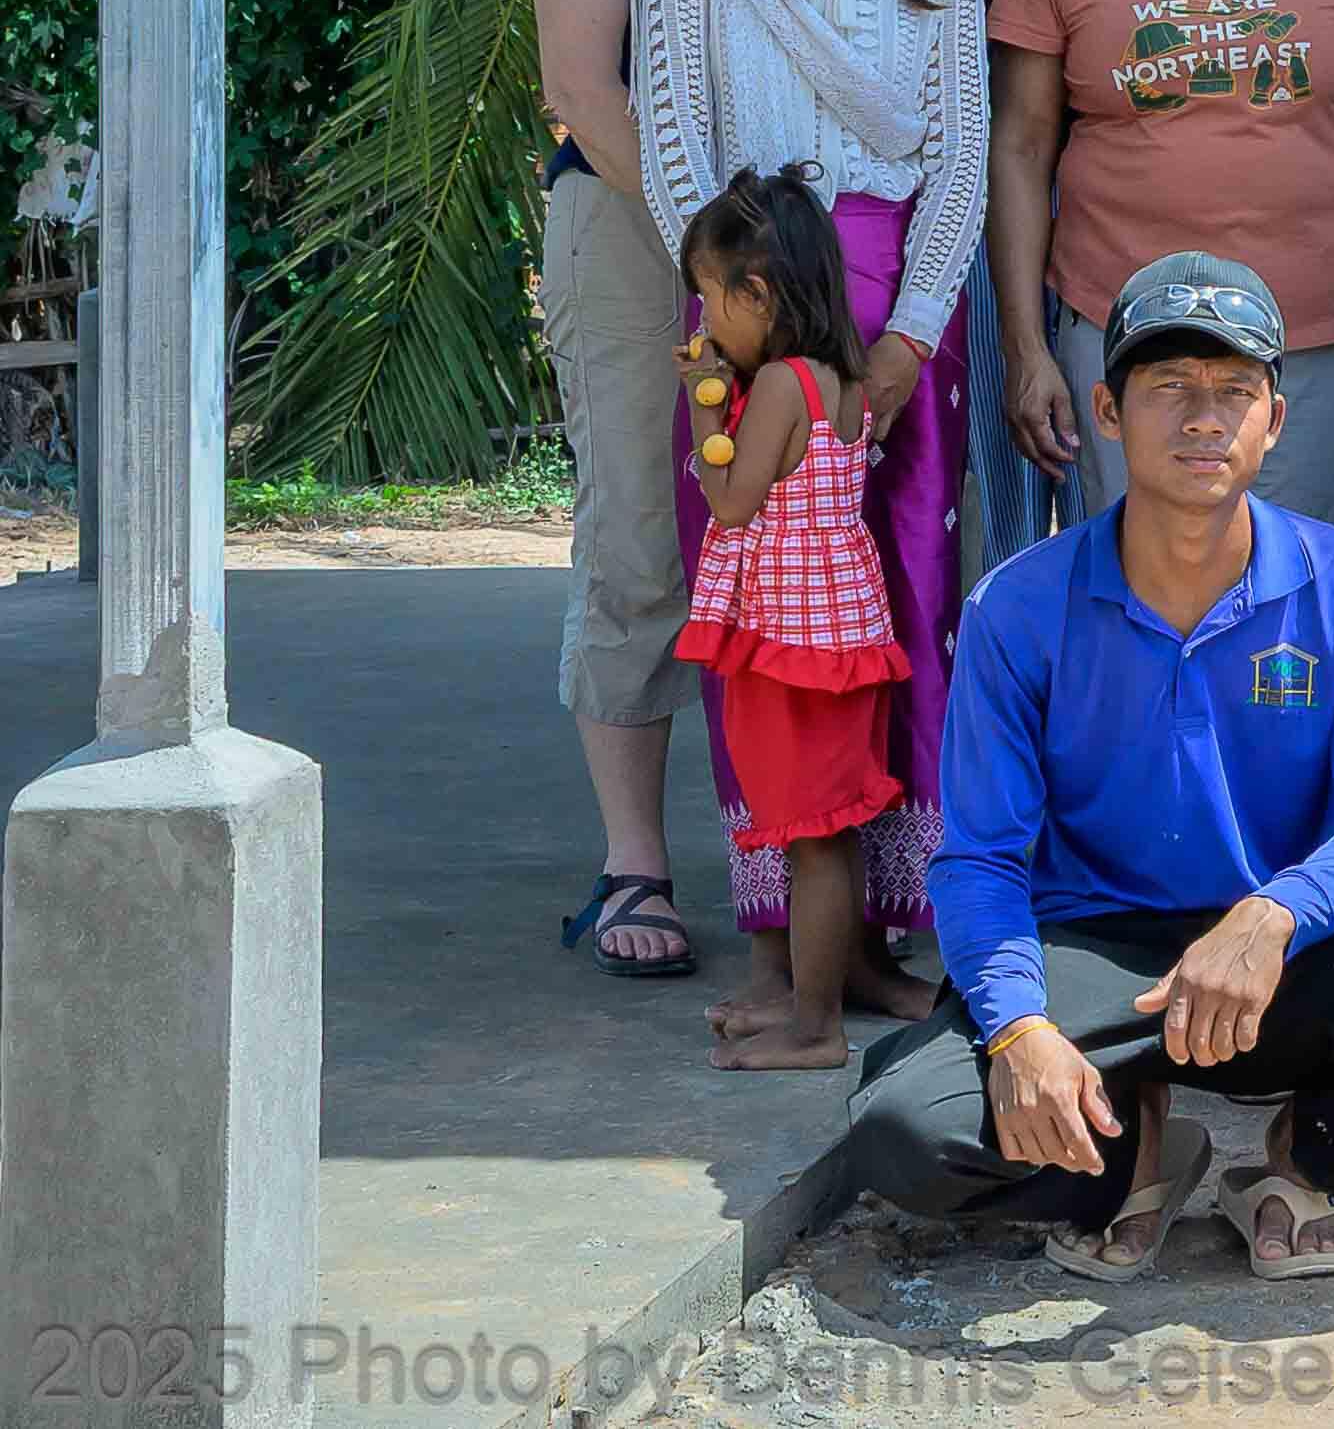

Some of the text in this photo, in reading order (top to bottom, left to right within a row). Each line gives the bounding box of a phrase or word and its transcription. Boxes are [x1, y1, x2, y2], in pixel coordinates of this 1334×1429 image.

[1132, 0, 1189, 22] WE
[1177, 19, 1247, 46] THE
[1111, 41, 1312, 91] NORTHEAST
